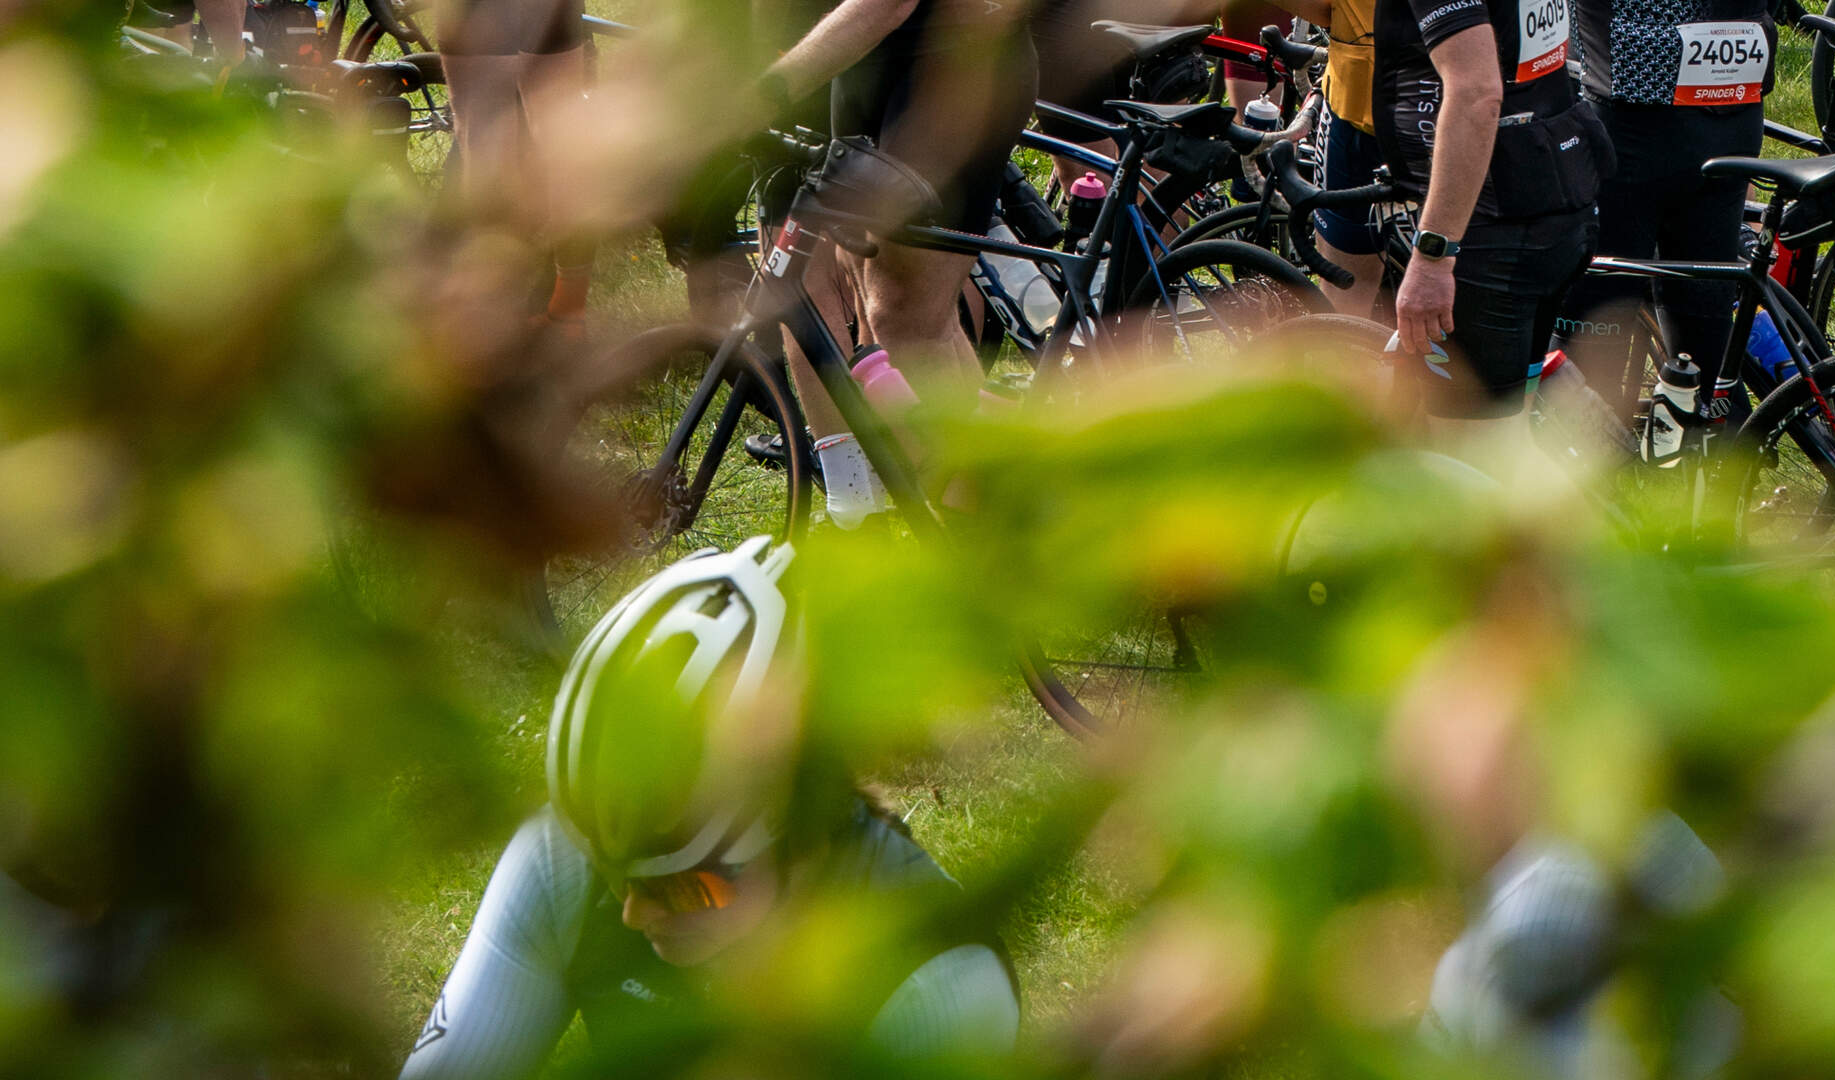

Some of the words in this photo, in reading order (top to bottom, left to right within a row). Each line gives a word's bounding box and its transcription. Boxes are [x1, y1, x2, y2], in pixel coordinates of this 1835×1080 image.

[1526, 0, 1565, 39] 04019
[1688, 39, 1764, 66] 24054
[1694, 88, 1736, 100] SPINDER
